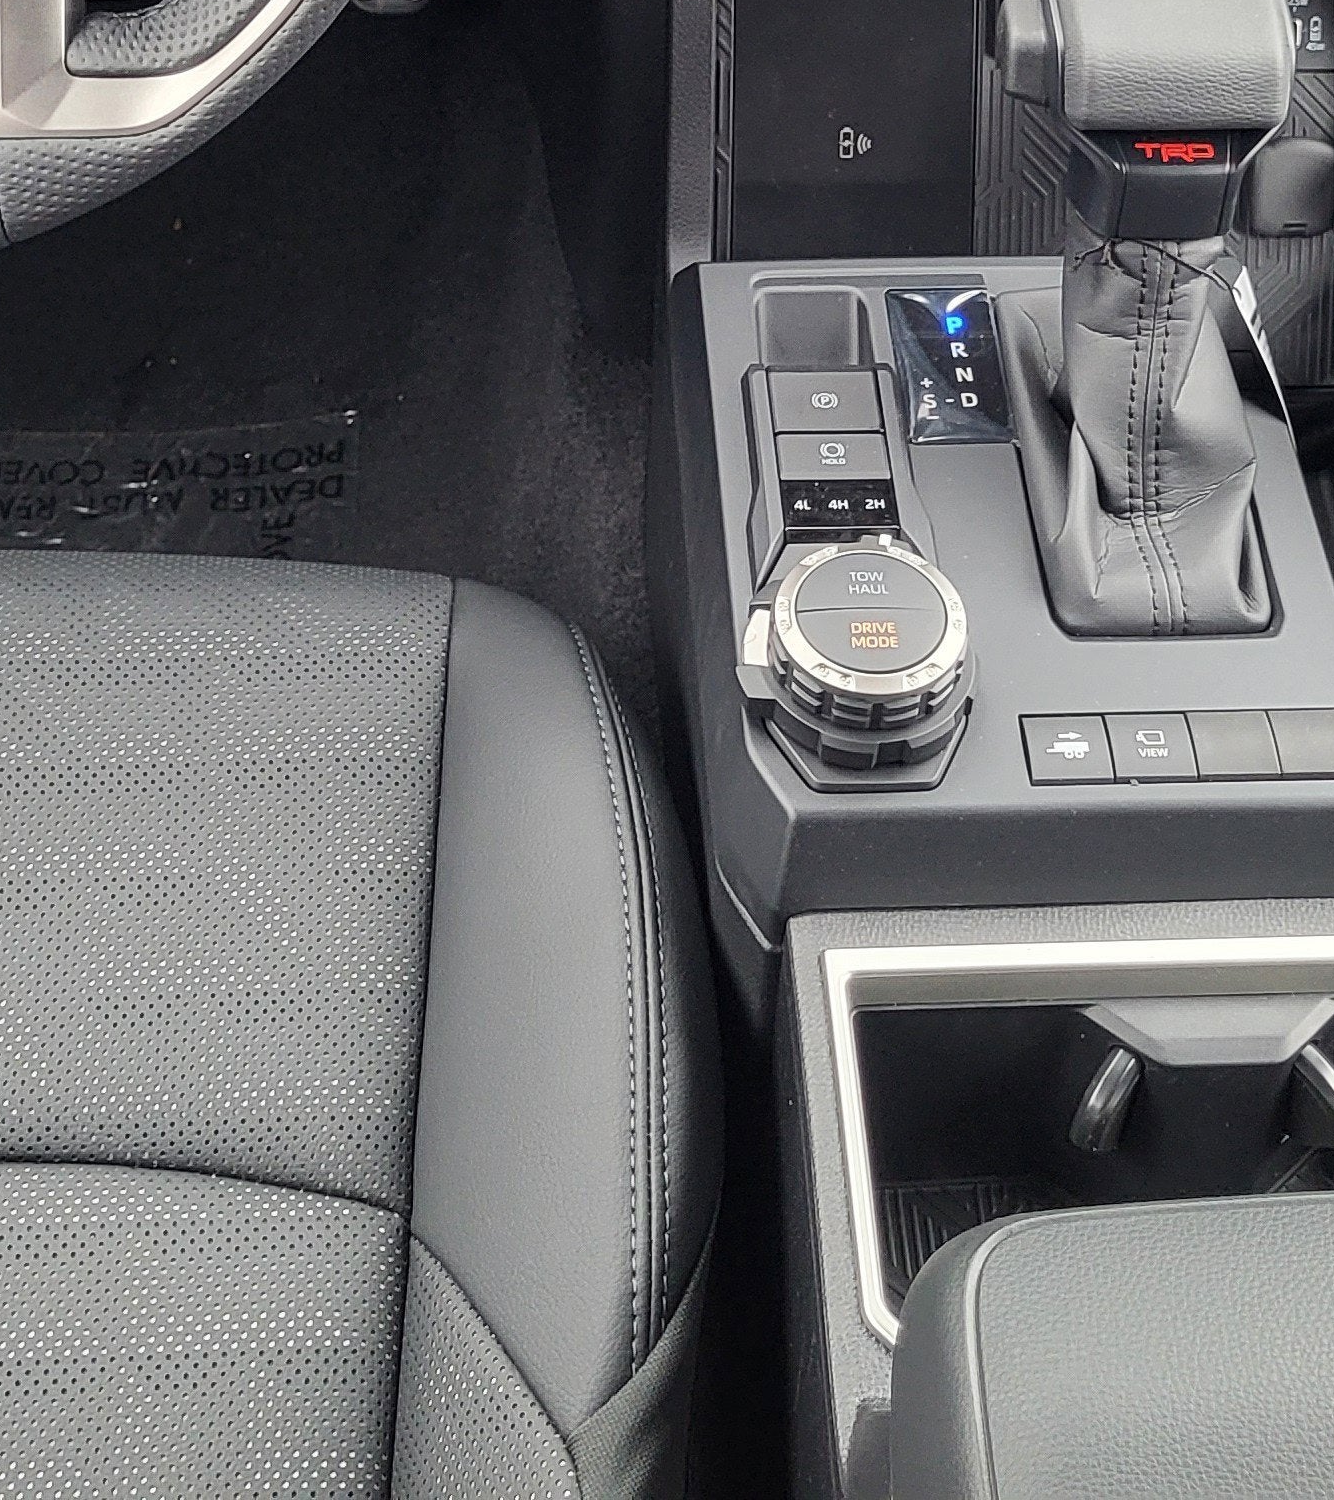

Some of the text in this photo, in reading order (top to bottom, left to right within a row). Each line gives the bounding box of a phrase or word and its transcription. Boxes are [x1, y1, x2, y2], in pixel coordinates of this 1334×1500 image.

[1134, 142, 1215, 163] TRD
[946, 316, 964, 334] P
[950, 342, 969, 358] R
[956, 367, 974, 382] N
[922, 394, 937, 409] S
[960, 392, 978, 408] D
[210, 474, 345, 513] DEALER
[794, 499, 811, 511] 4L
[828, 499, 849, 510] 4H
[865, 498, 886, 510] 2H
[849, 572, 884, 582] TOW
[849, 584, 889, 595] HAUL
[851, 622, 896, 634] DRIVE
[851, 636, 899, 649] MODE
[1137, 747, 1169, 758] VIEW
